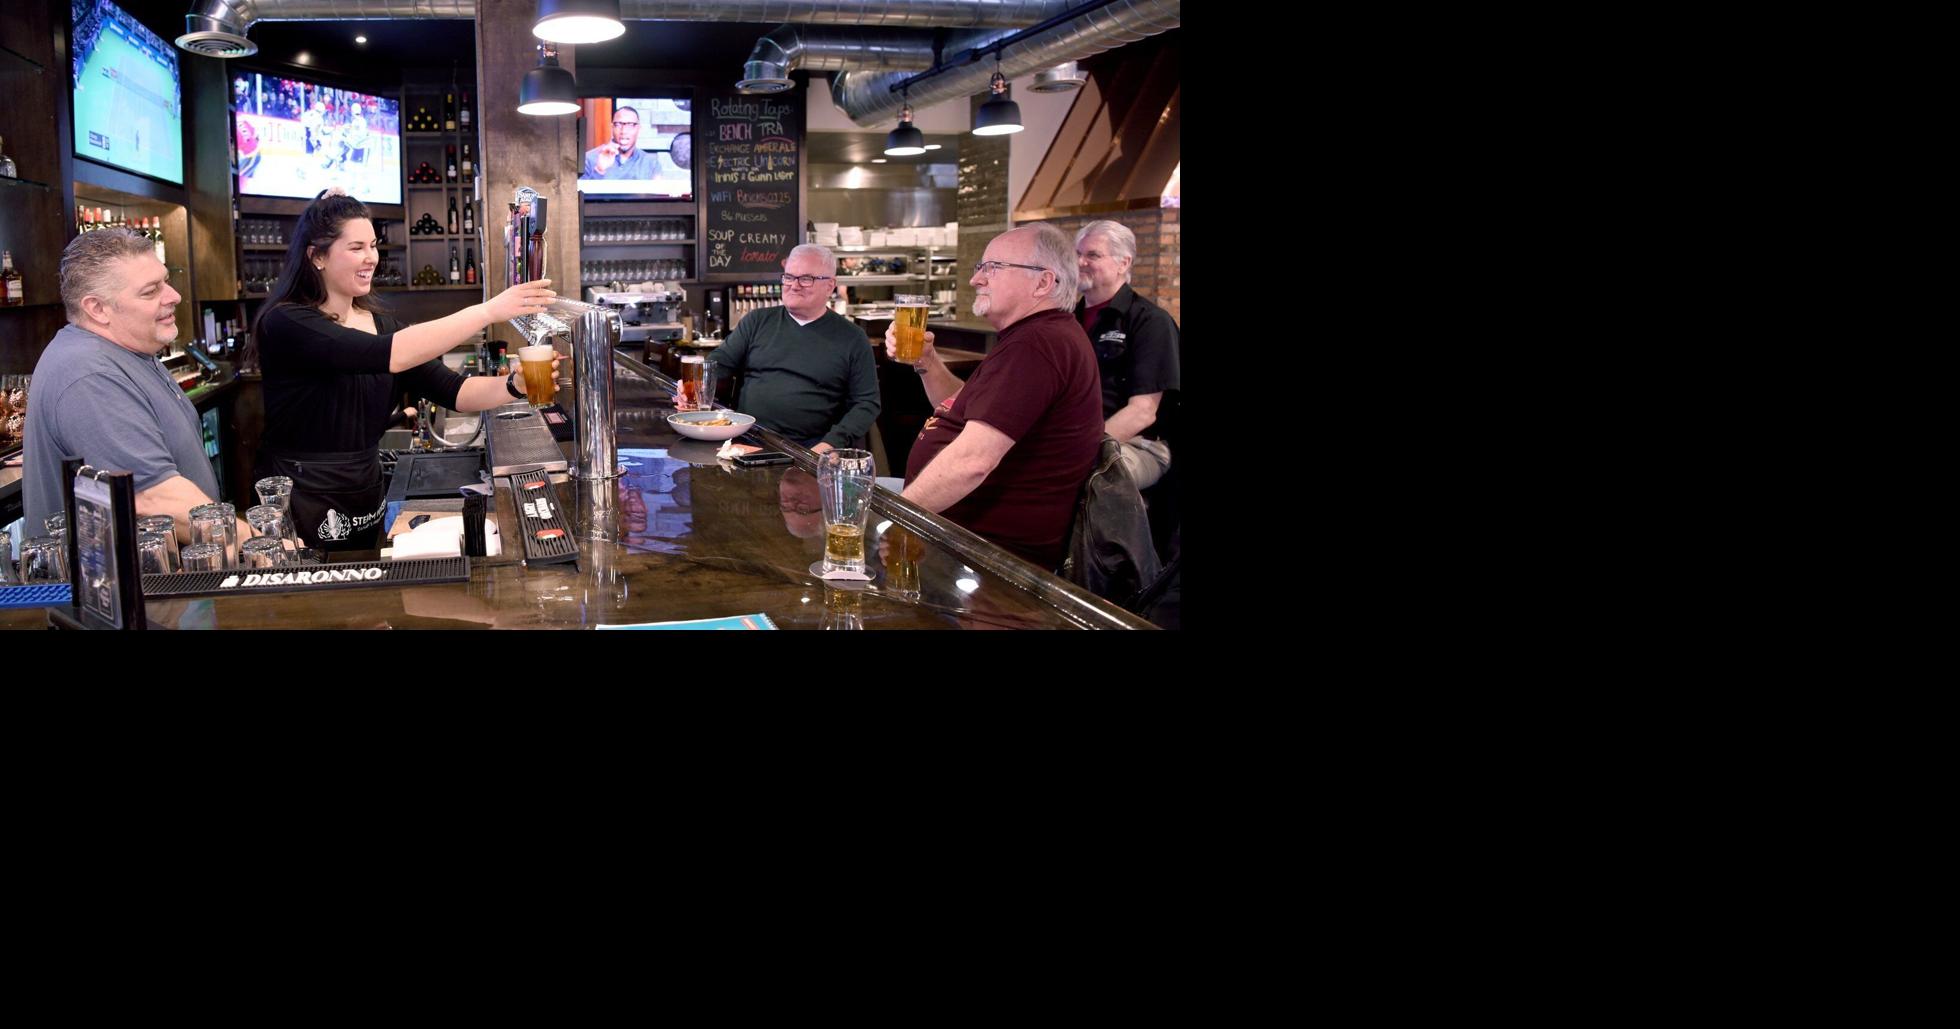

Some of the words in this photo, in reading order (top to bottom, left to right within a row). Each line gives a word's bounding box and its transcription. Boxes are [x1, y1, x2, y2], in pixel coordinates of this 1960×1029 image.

[719, 123, 752, 141] BENCH
[708, 229, 735, 242] SOUP
[739, 233, 786, 245] CREAMY
[709, 255, 732, 268] DAY
[241, 568, 382, 586] DISARONNO
